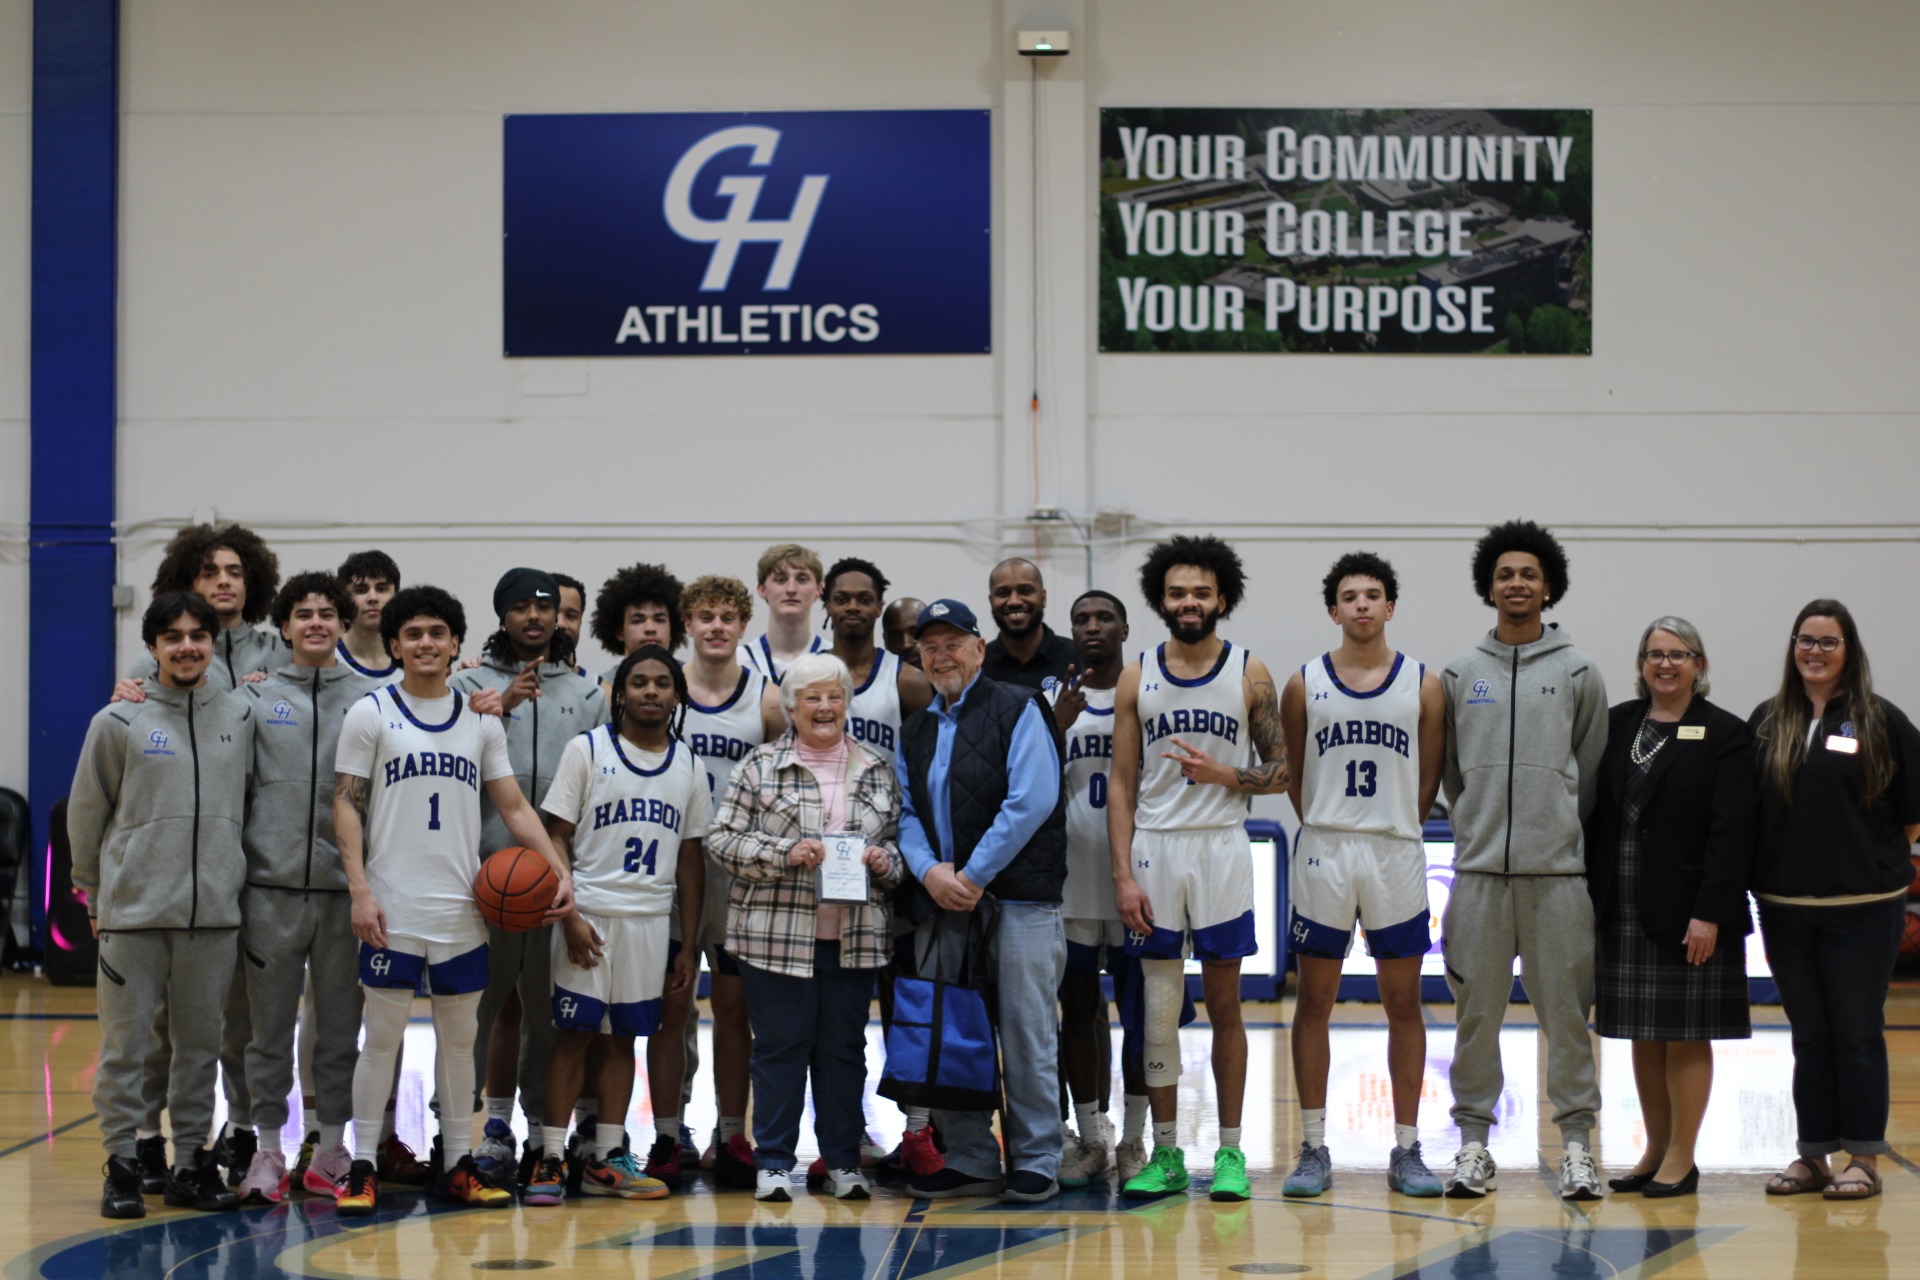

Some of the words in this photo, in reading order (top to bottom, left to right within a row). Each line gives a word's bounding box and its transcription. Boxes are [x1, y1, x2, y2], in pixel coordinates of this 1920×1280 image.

[1118, 126, 1245, 181] YOUR
[1265, 126, 1573, 183] COMMUNITY
[662, 124, 830, 291] GH
[1117, 202, 1245, 257] YOUR
[1265, 201, 1473, 258] COLLEGE
[615, 304, 880, 344] ATHLETICS
[1117, 276, 1245, 332] YOUR
[1265, 277, 1495, 334] PURPOSE
[1472, 679, 1490, 698] GH
[273, 700, 292, 719] GH
[1144, 708, 1239, 748] HARBOR
[149, 729, 169, 749] GH
[690, 733, 756, 762] RBO
[844, 716, 896, 753] BOR
[1314, 720, 1410, 759] HARBOR
[385, 751, 478, 792] HARBOR
[1089, 772, 1107, 808] 0
[1345, 760, 1377, 797] 13
[428, 792, 441, 831] 1
[623, 836, 659, 875] 24
[1293, 920, 1310, 943] GH
[370, 953, 392, 976] GH
[559, 996, 578, 1019] GH
